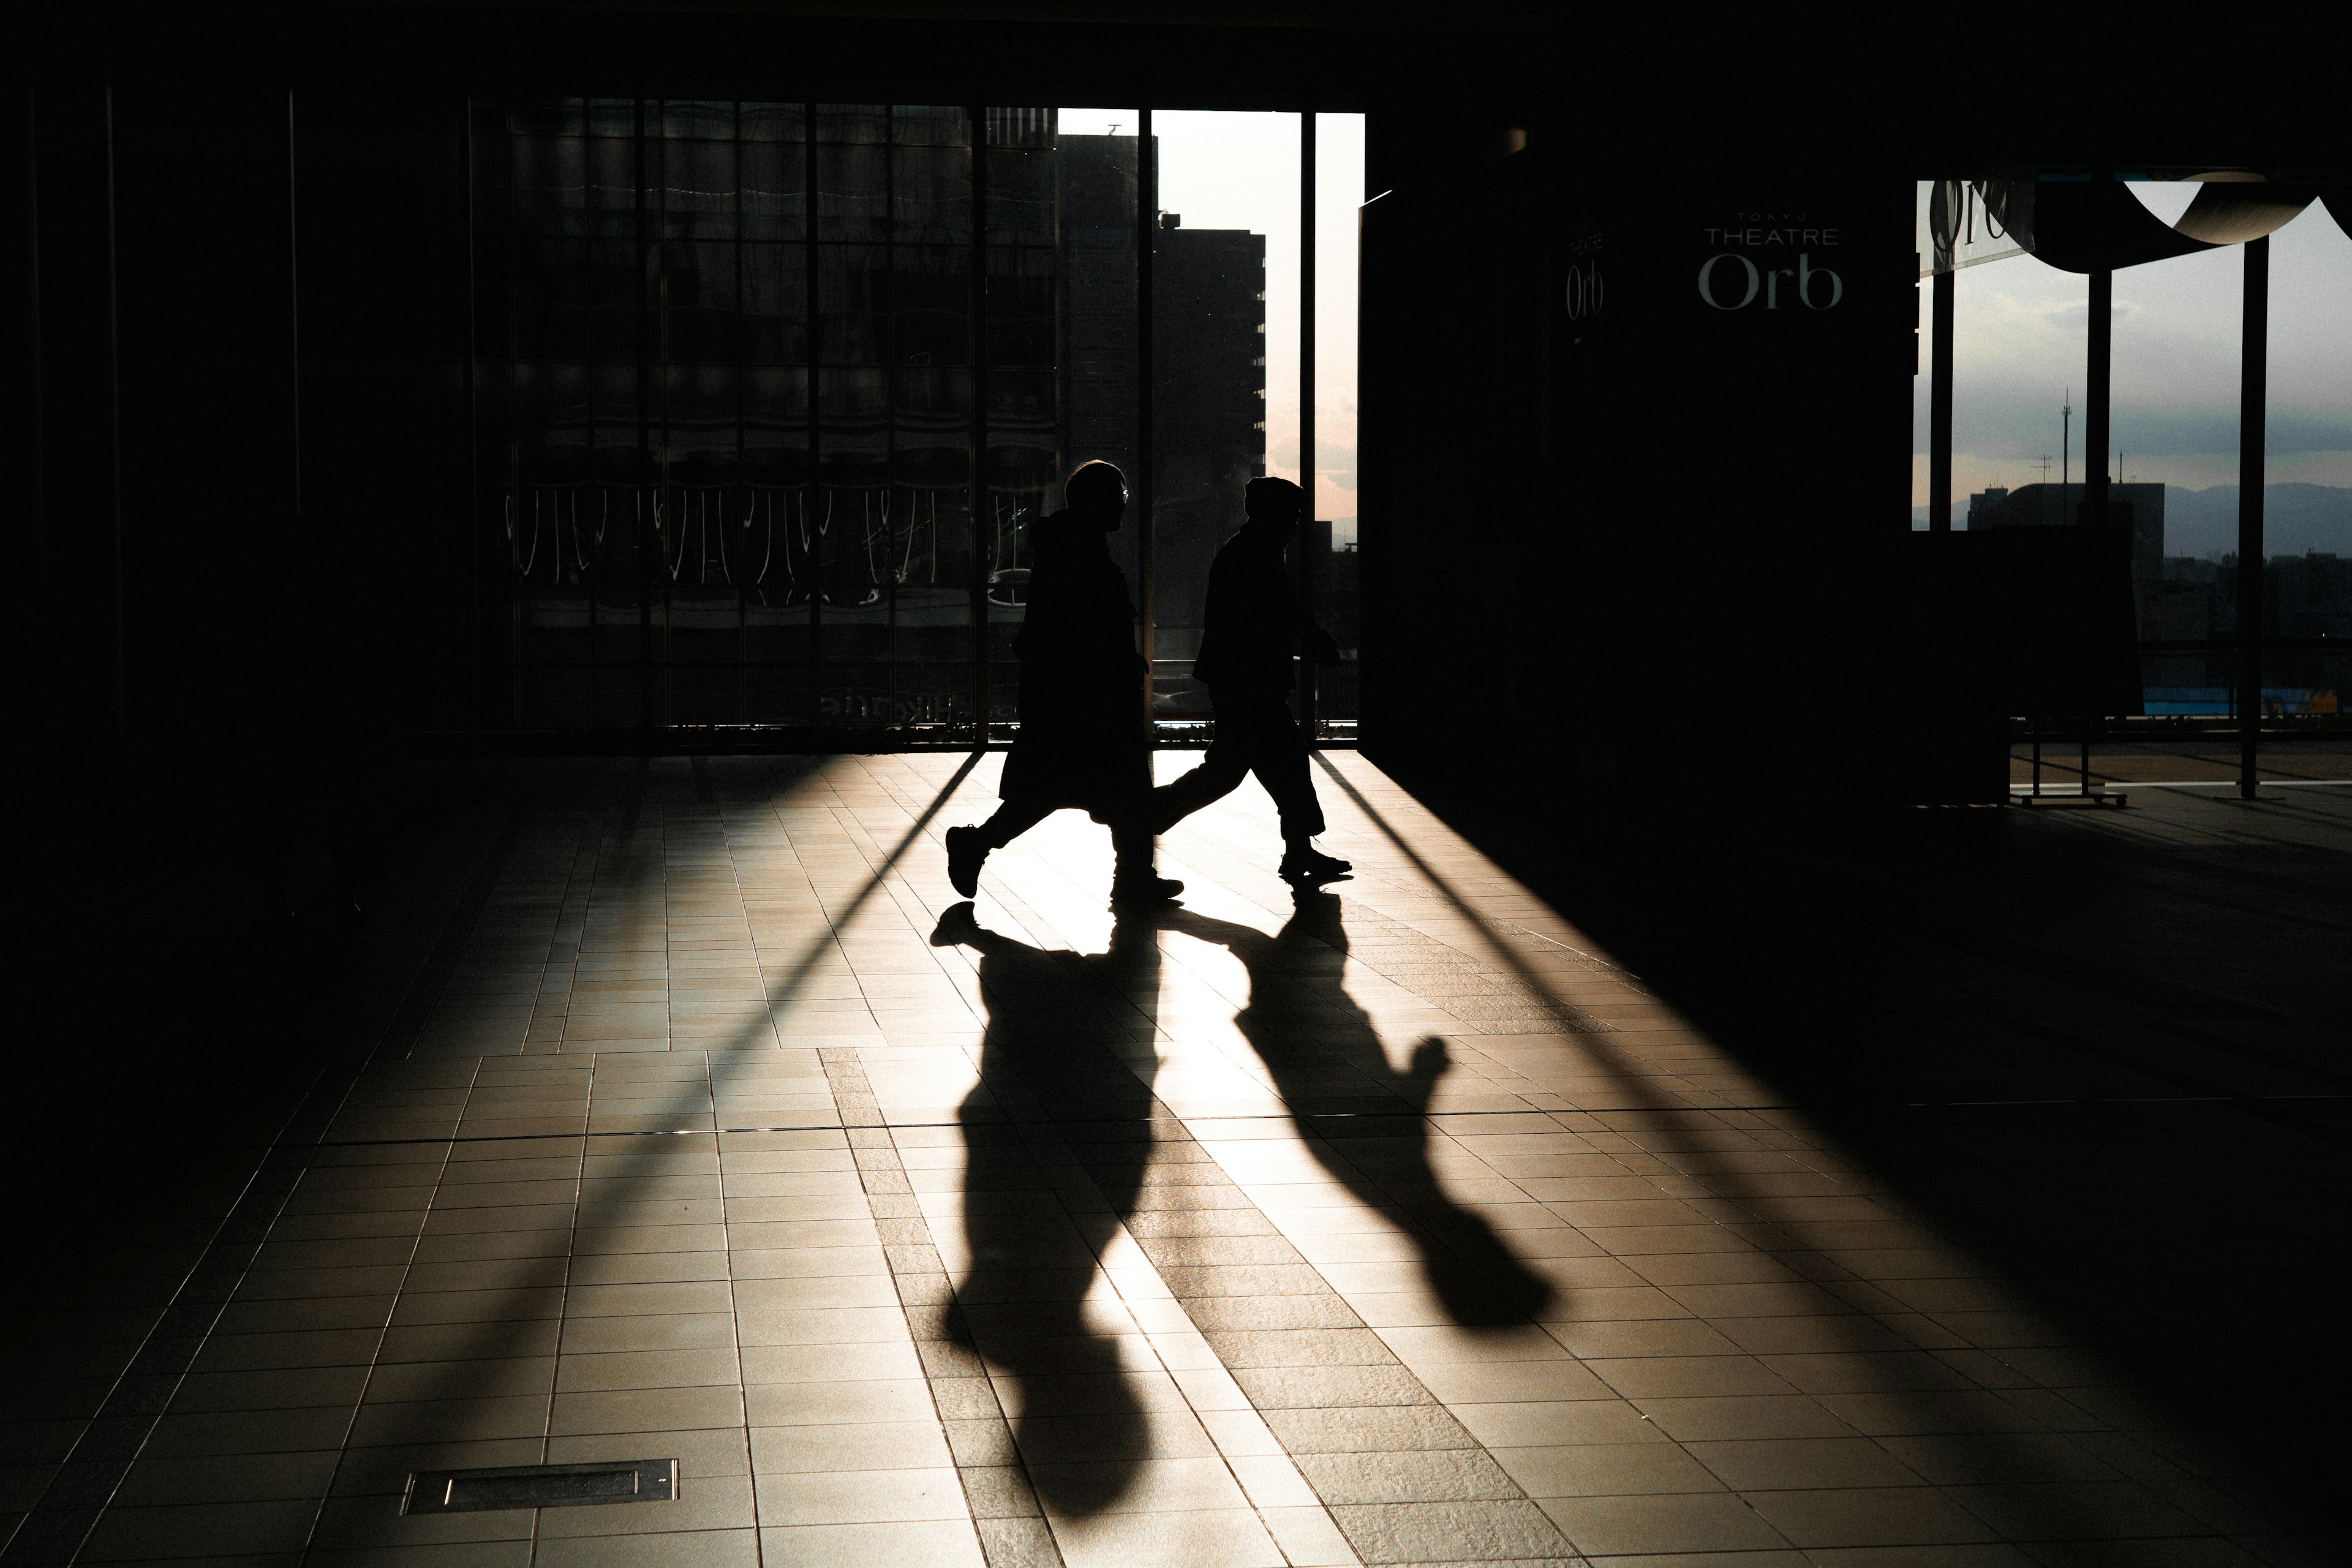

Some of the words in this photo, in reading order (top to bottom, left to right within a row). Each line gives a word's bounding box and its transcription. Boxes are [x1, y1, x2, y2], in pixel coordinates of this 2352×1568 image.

[1738, 213, 1806, 221] TOKYU
[1703, 228, 1839, 245] THEATRE
[1567, 258, 1604, 320] Orb
[1697, 252, 1843, 311] Orb
